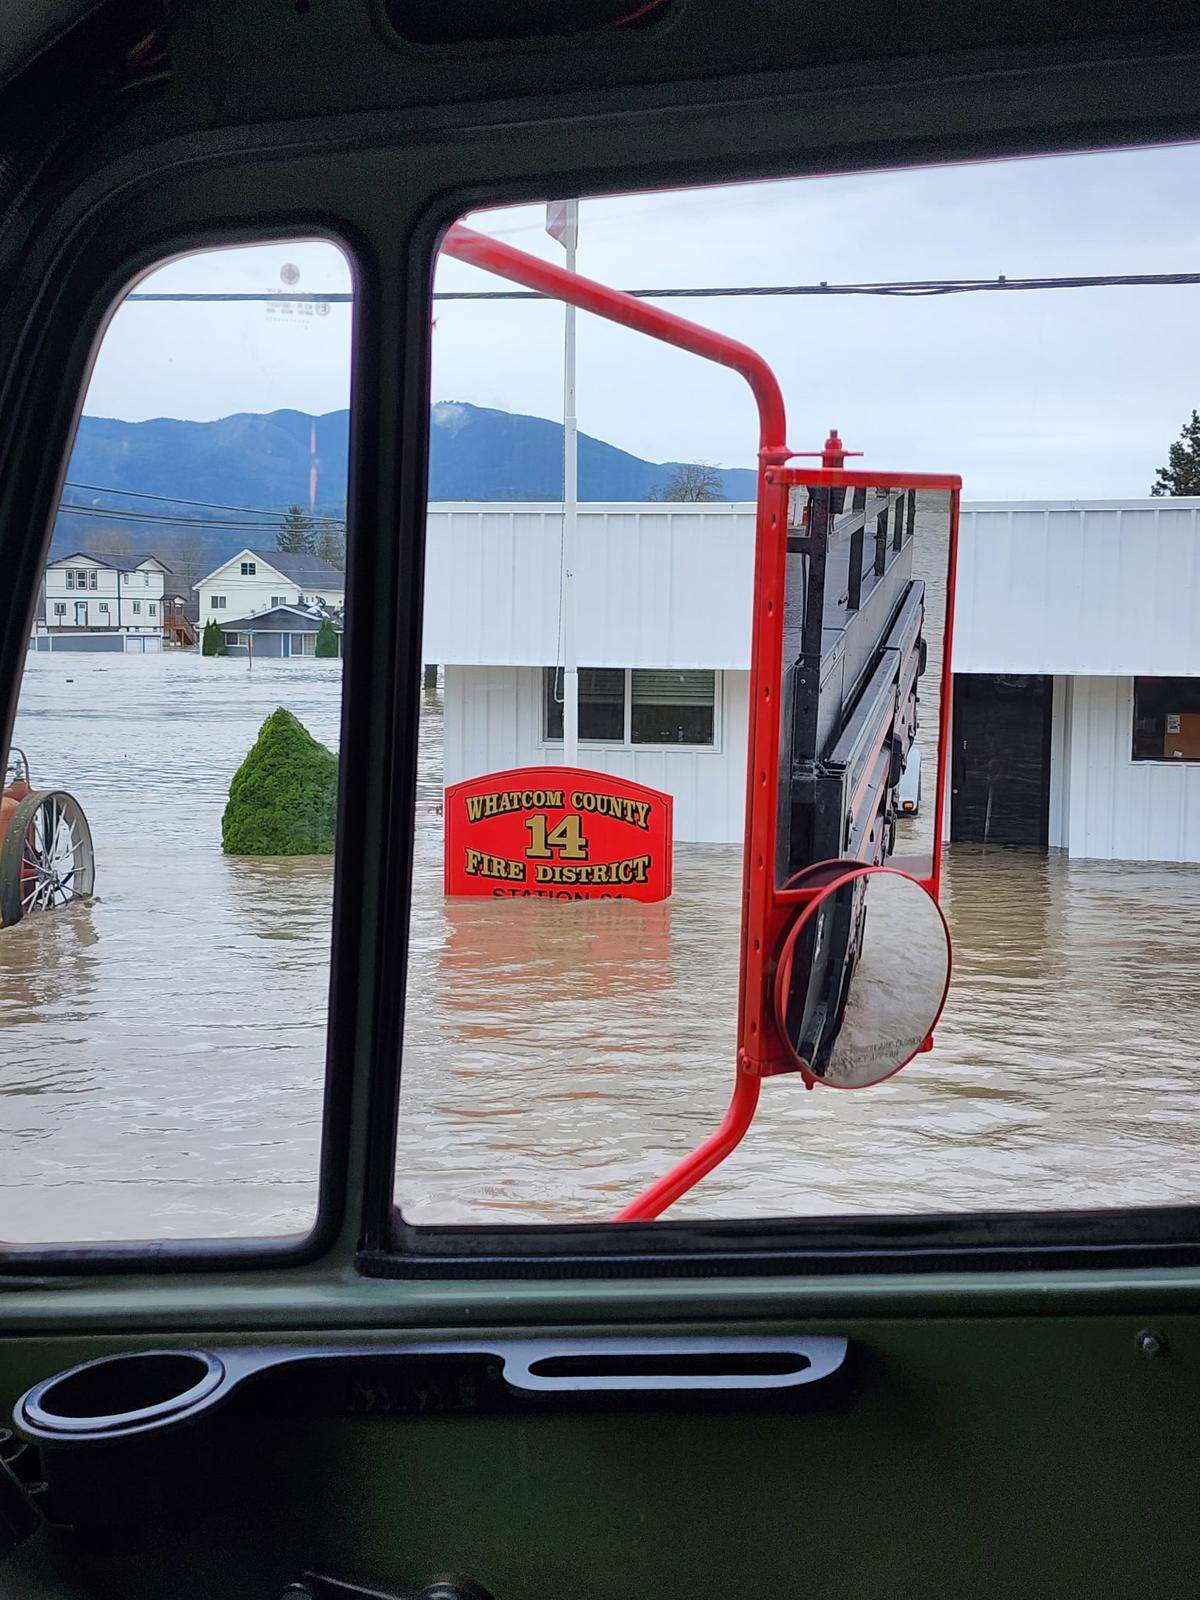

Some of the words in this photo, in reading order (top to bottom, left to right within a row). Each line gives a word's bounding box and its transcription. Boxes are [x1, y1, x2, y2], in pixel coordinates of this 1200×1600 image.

[465, 790, 565, 823] WHATCOM
[571, 791, 651, 830] COUNTY
[525, 814, 588, 860] 14
[465, 848, 526, 881] FIRE
[535, 855, 651, 884] DISTRICT
